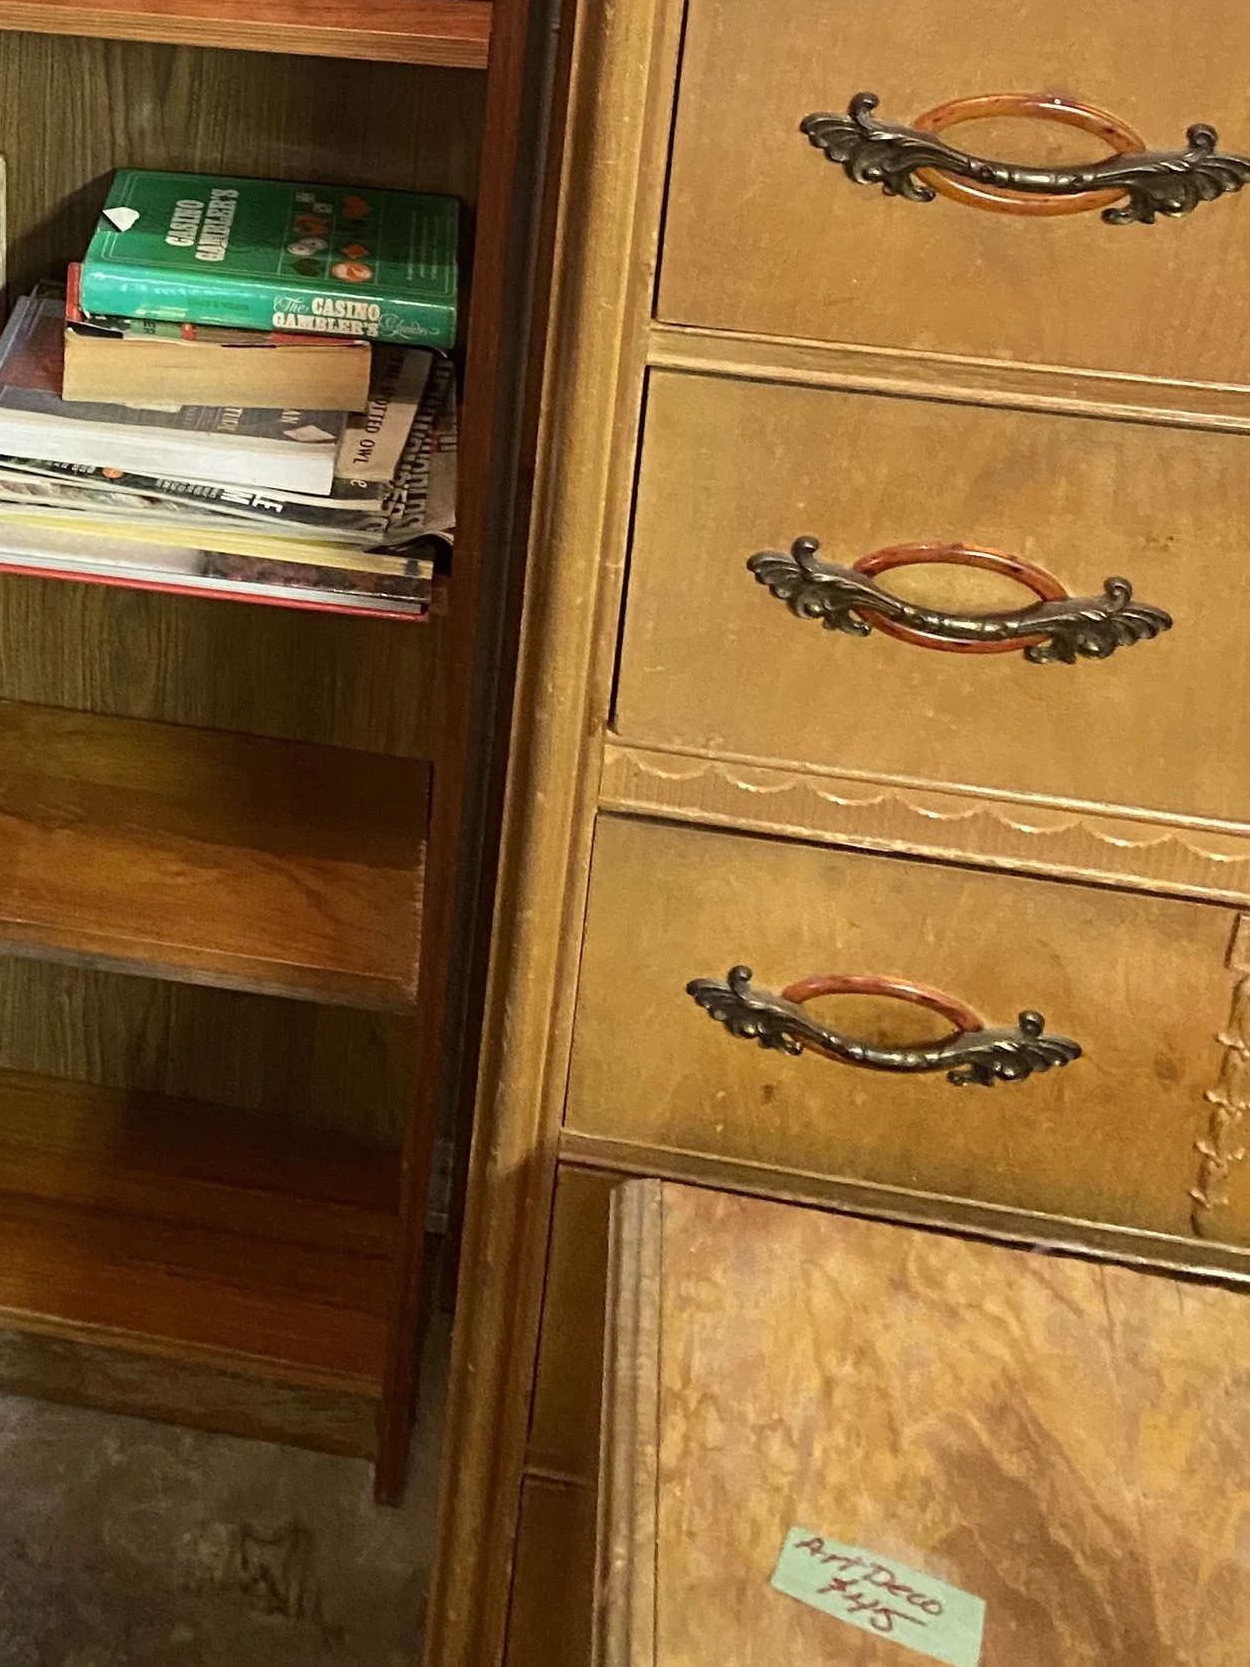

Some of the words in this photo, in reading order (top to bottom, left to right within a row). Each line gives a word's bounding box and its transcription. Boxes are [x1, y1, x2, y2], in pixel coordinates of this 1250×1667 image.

[165, 198, 205, 248] CASINO
[194, 188, 240, 262] GAMBLER'S
[272, 312, 380, 339] GAMBLER'S
[273, 295, 310, 316] The
[310, 297, 382, 322] CASINO
[352, 438, 375, 464] OWL
[794, 1536, 867, 1572] Art
[862, 1562, 944, 1617] Deco
